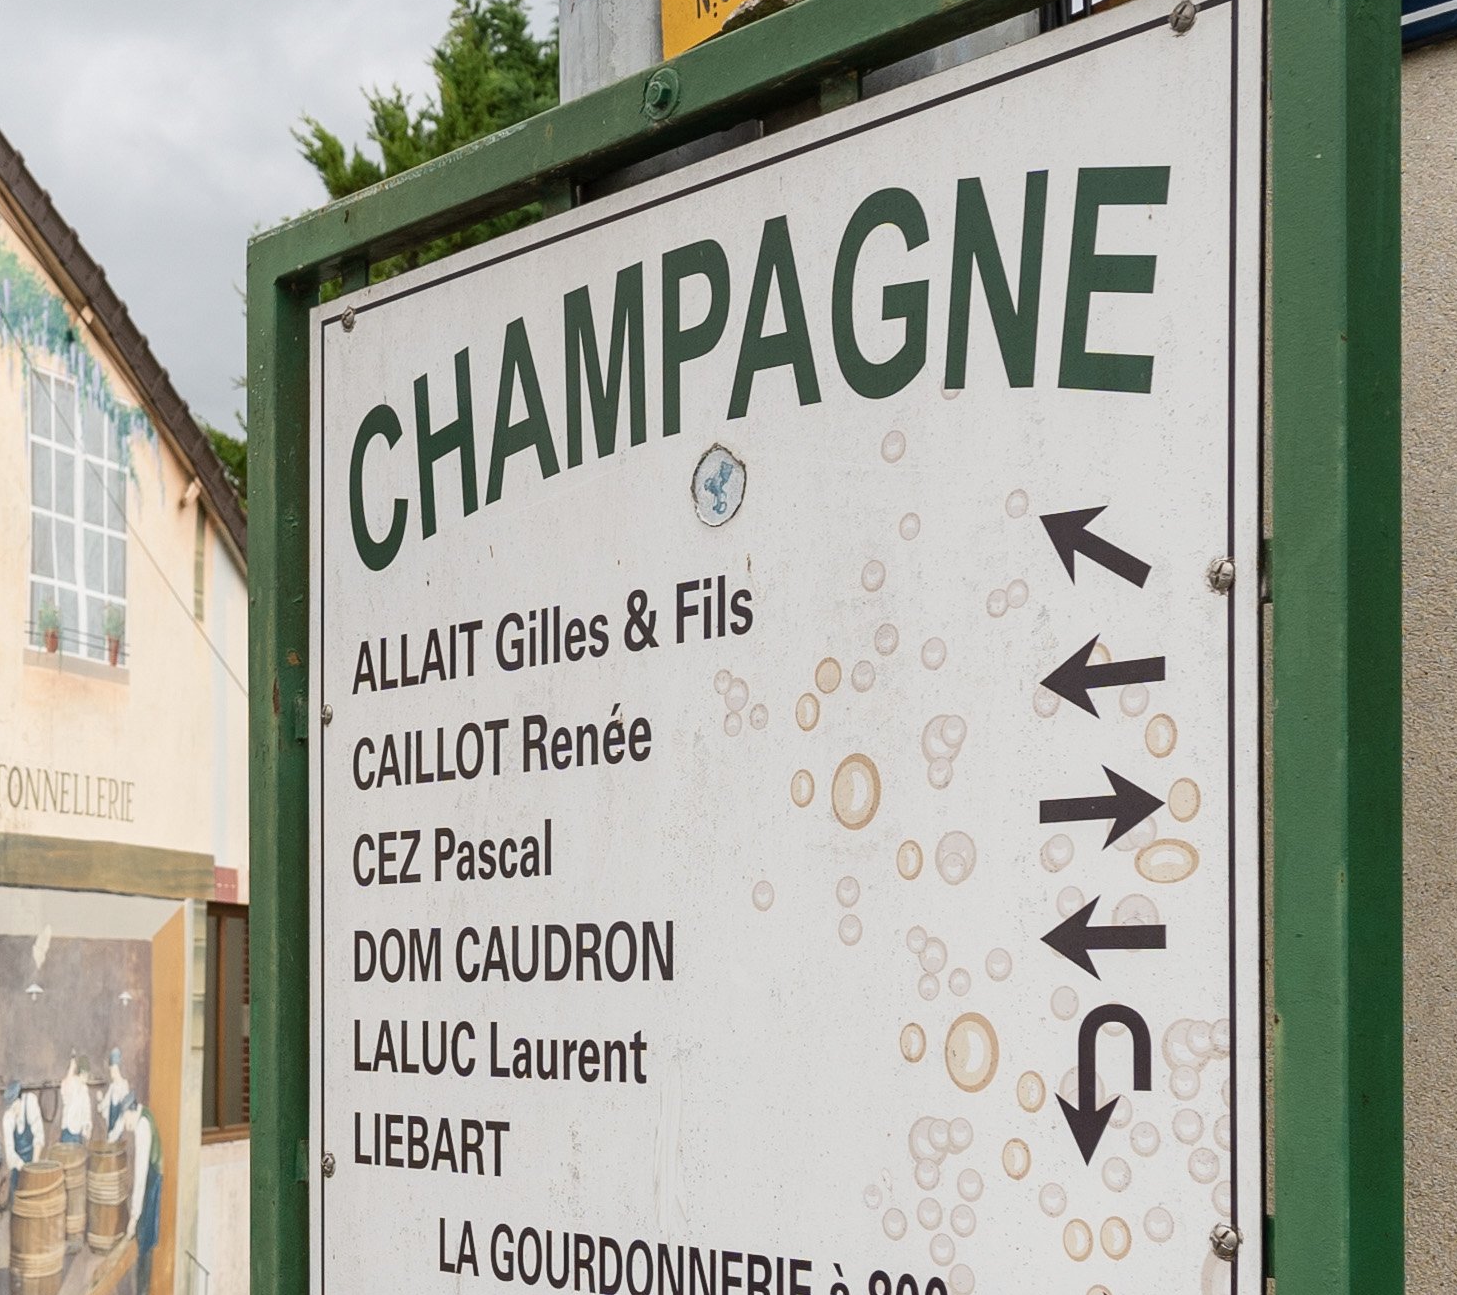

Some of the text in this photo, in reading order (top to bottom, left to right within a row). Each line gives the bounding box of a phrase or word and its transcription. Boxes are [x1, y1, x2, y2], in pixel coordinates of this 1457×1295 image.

[350, 166, 1170, 571] CHAMPAGNE
[352, 575, 753, 694] ALLAIT Gilles & Fils
[353, 703, 651, 790] CAILLOT Renée
[354, 819, 551, 886] CEZ Pascal
[355, 921, 673, 983] DOM CAUDRON
[355, 1020, 647, 1084] LALUC Laurent
[355, 1112, 509, 1176] LIEBART
[440, 1218, 479, 1276] LA
